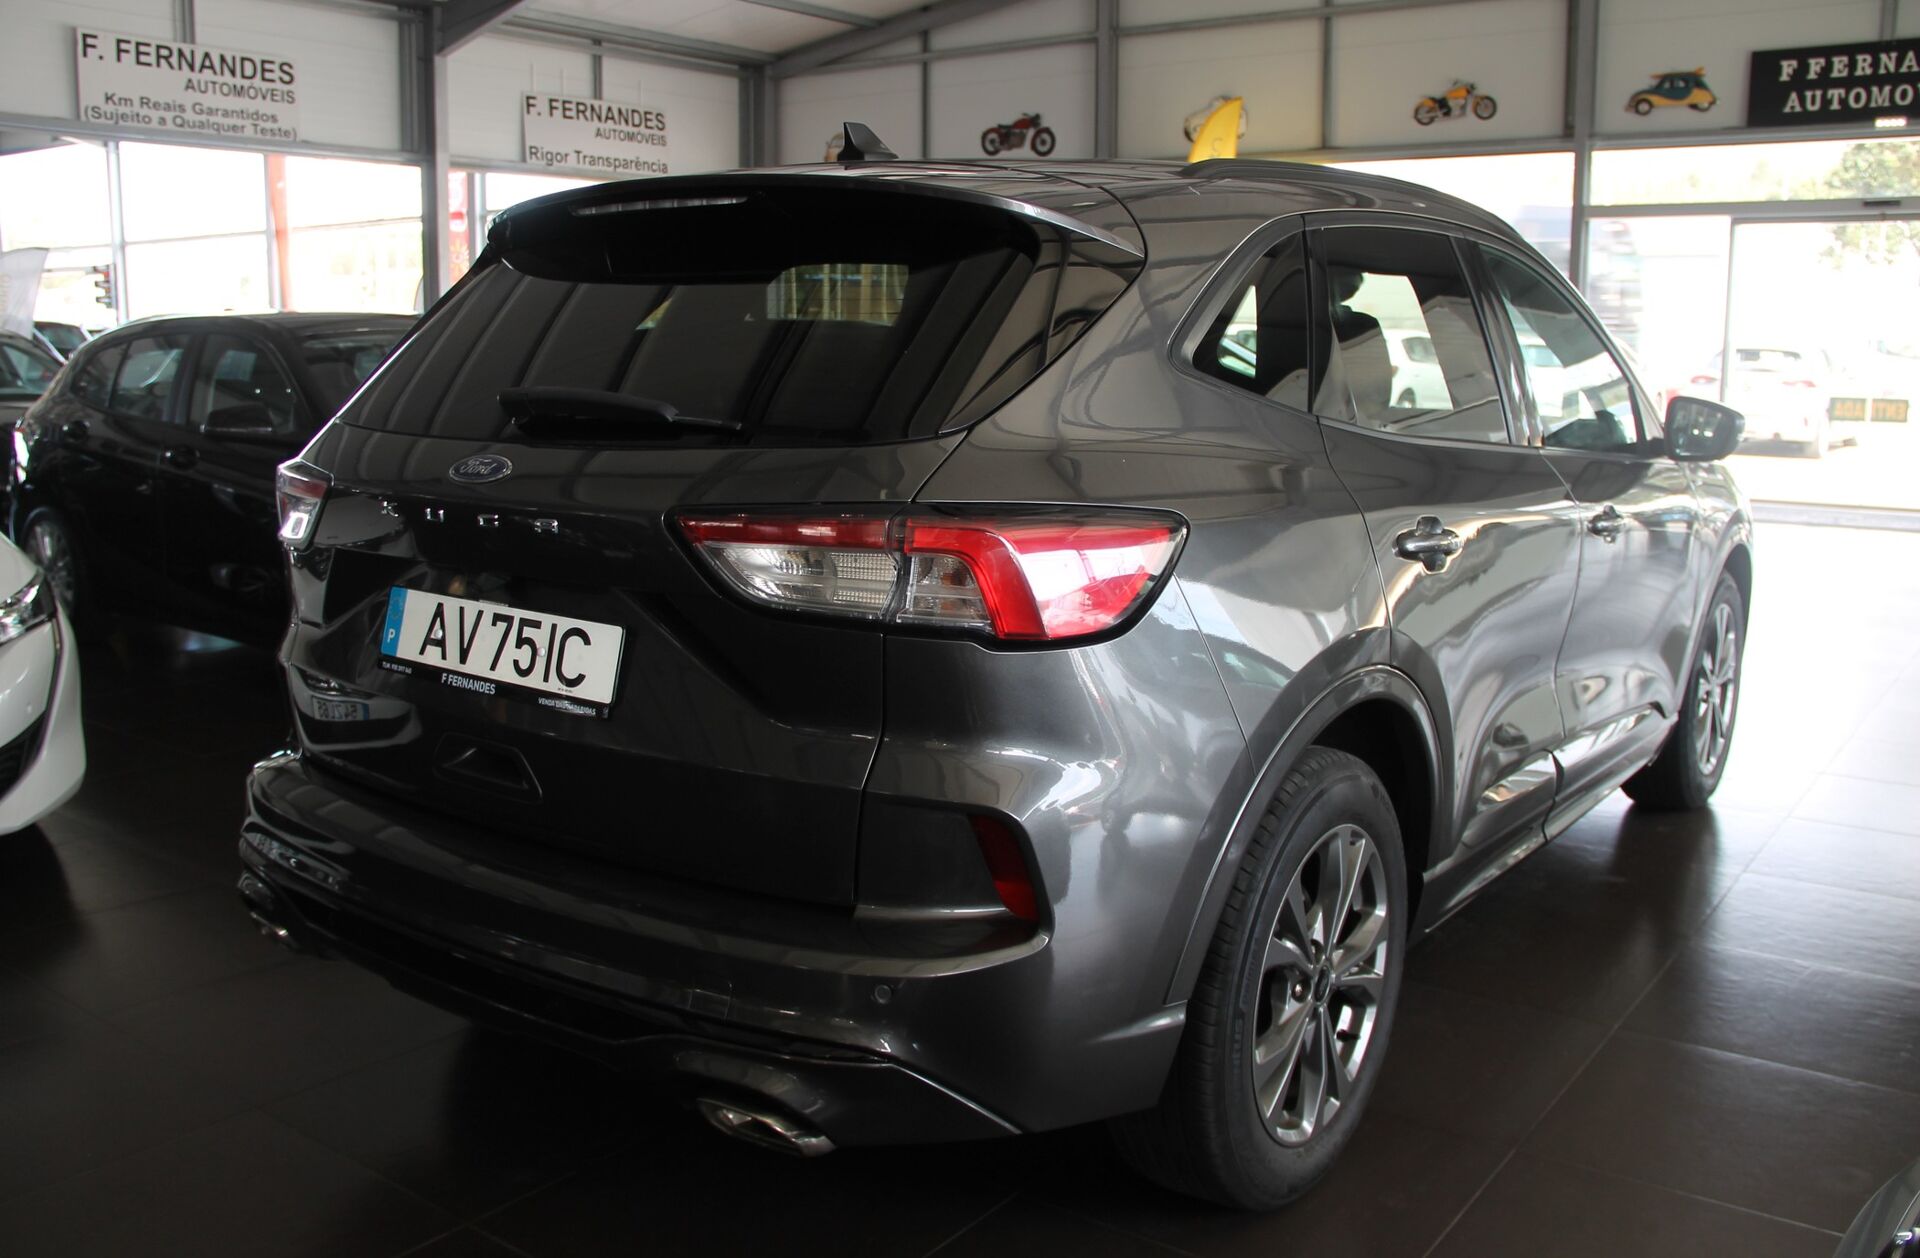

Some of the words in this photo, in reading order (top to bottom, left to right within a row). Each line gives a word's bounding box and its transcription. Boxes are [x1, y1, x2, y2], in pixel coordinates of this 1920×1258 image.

[80, 32, 104, 60] F.
[115, 38, 296, 85] FERNANDES
[1778, 59, 1798, 82] F
[1805, 50, 1920, 80] FERNA
[104, 91, 134, 107] Km
[139, 96, 187, 114] Reais
[192, 102, 279, 124] Garantidos
[184, 78, 297, 105] AUTOMÓVEIS
[1783, 84, 1920, 113] AUTOMO
[83, 105, 152, 125] (Sujeito
[157, 114, 167, 126] a
[172, 115, 246, 135] Qualquer
[251, 123, 298, 142] Teste)
[525, 95, 542, 117] F.
[549, 98, 666, 131] FERNANDES
[595, 127, 668, 147] AUTOMÓVEIS
[528, 145, 570, 166] Rigor
[574, 150, 669, 174] Transparência
[387, 628, 396, 643] P
[418, 601, 592, 688] AV75IC
[448, 673, 496, 695] FERNANDES
